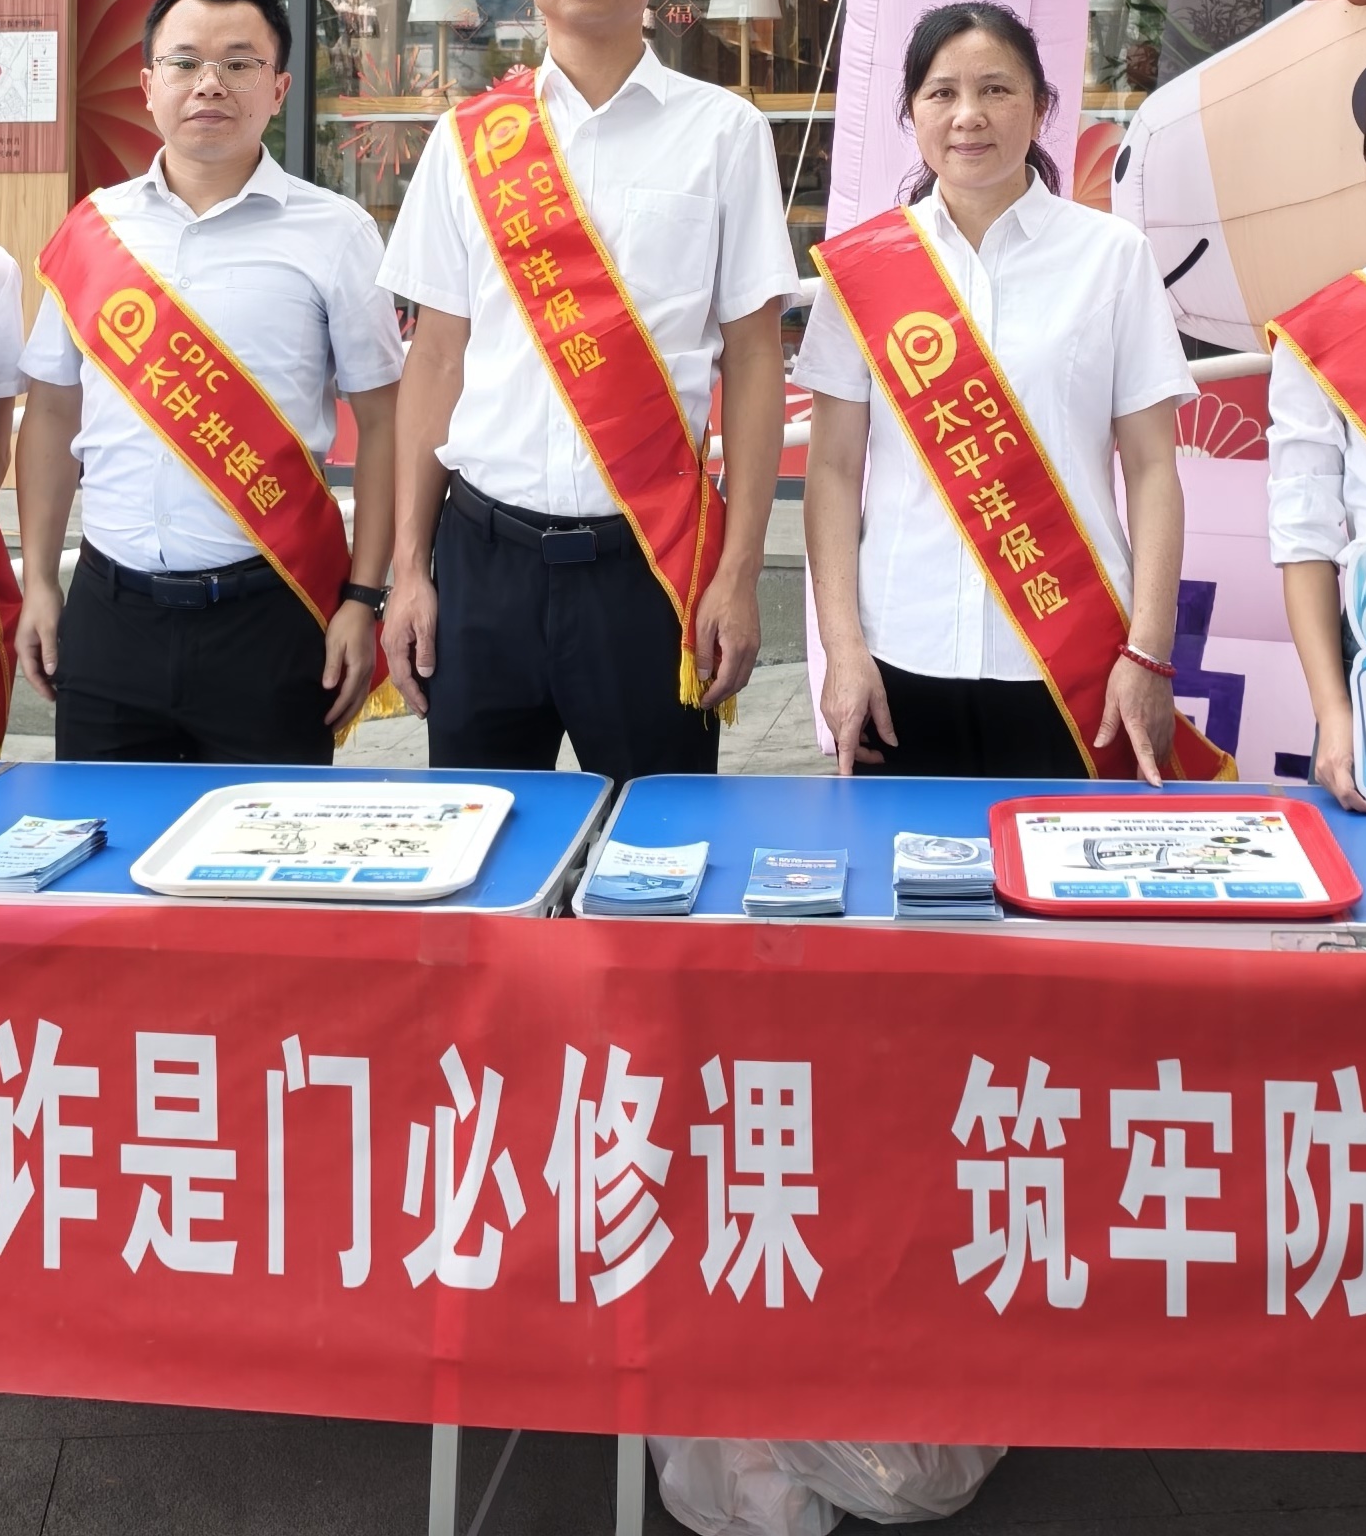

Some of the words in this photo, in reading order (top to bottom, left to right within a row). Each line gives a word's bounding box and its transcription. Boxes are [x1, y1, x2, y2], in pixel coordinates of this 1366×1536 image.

[666, 3, 693, 24] 福
[526, 160, 566, 227] CPIC
[488, 178, 607, 378] 太平洋保险
[168, 330, 232, 395] CPIC
[140, 354, 287, 516] 太平洋保险
[963, 377, 1018, 456] CPIC
[923, 397, 1071, 620] 太平洋保险
